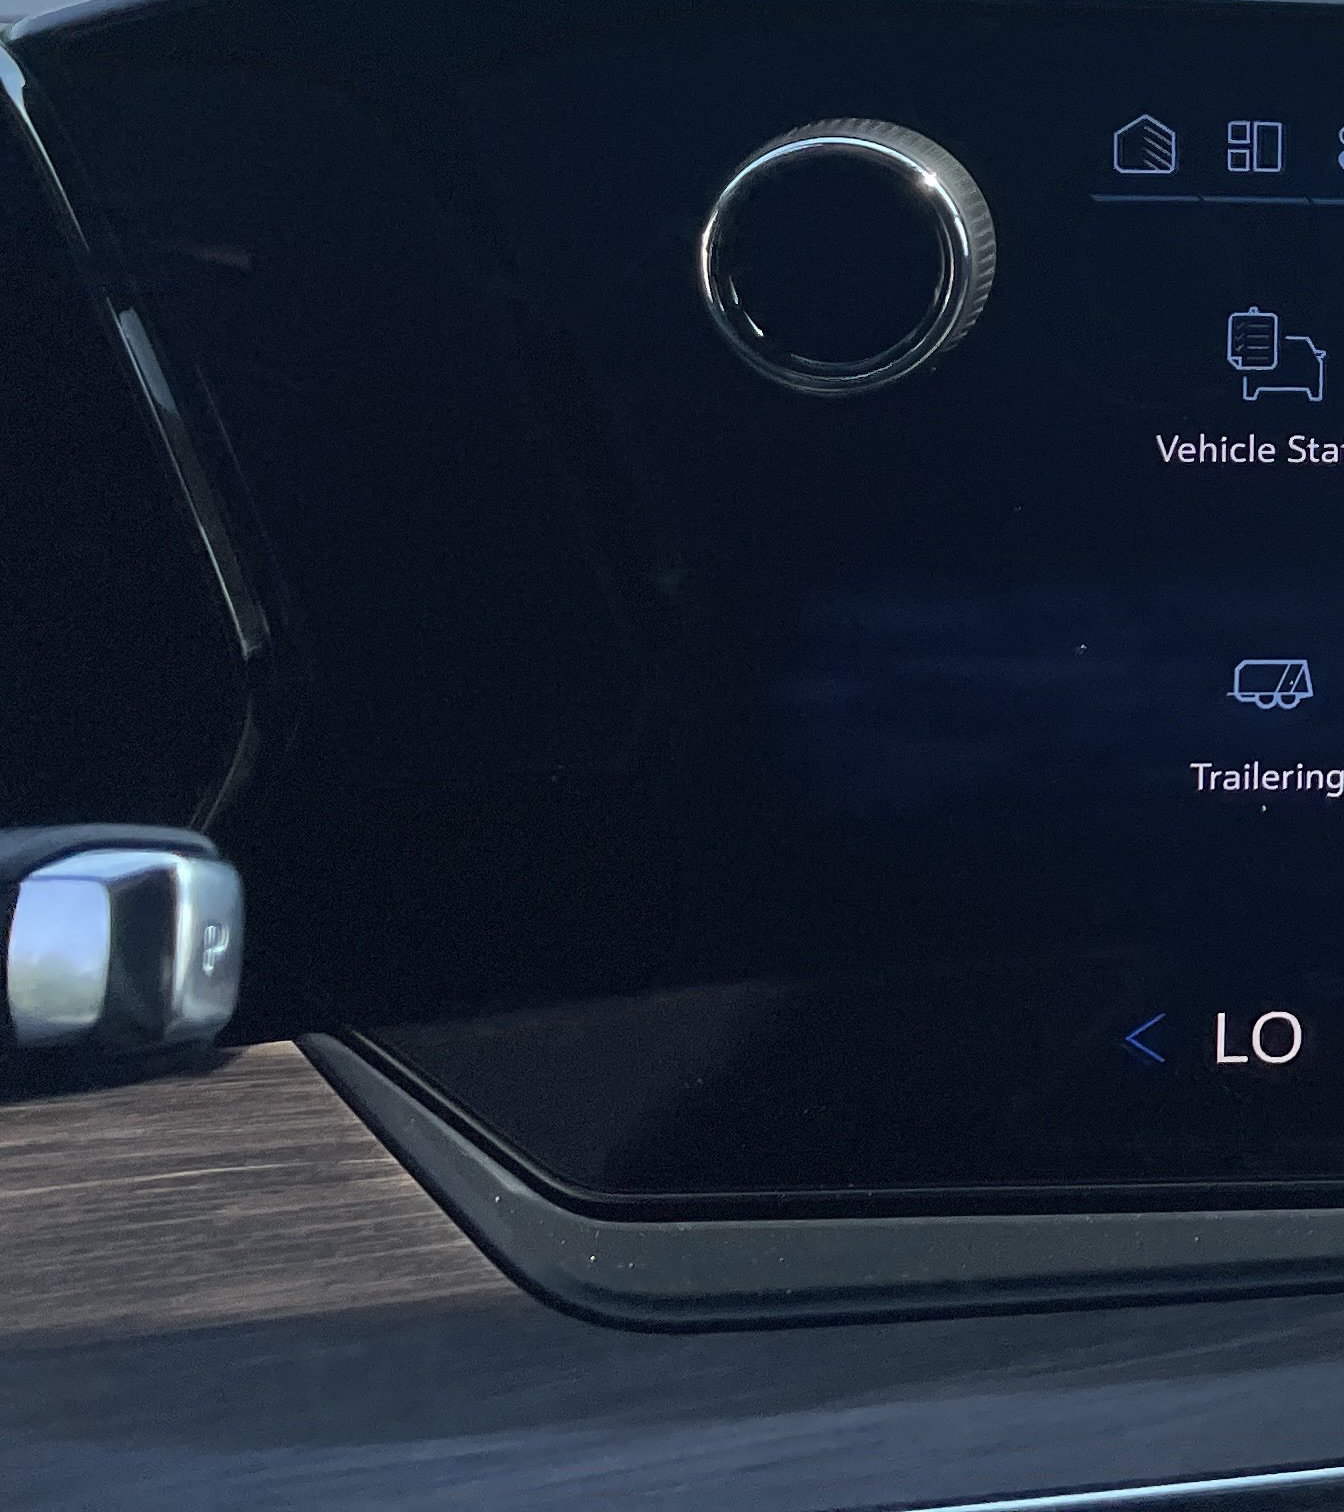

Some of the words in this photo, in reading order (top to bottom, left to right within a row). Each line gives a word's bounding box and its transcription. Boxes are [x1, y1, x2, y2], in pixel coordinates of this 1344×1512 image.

[1155, 433, 1276, 464] Vehicle
[1189, 760, 1344, 798] Trailering
[1216, 1011, 1302, 1064] LO
